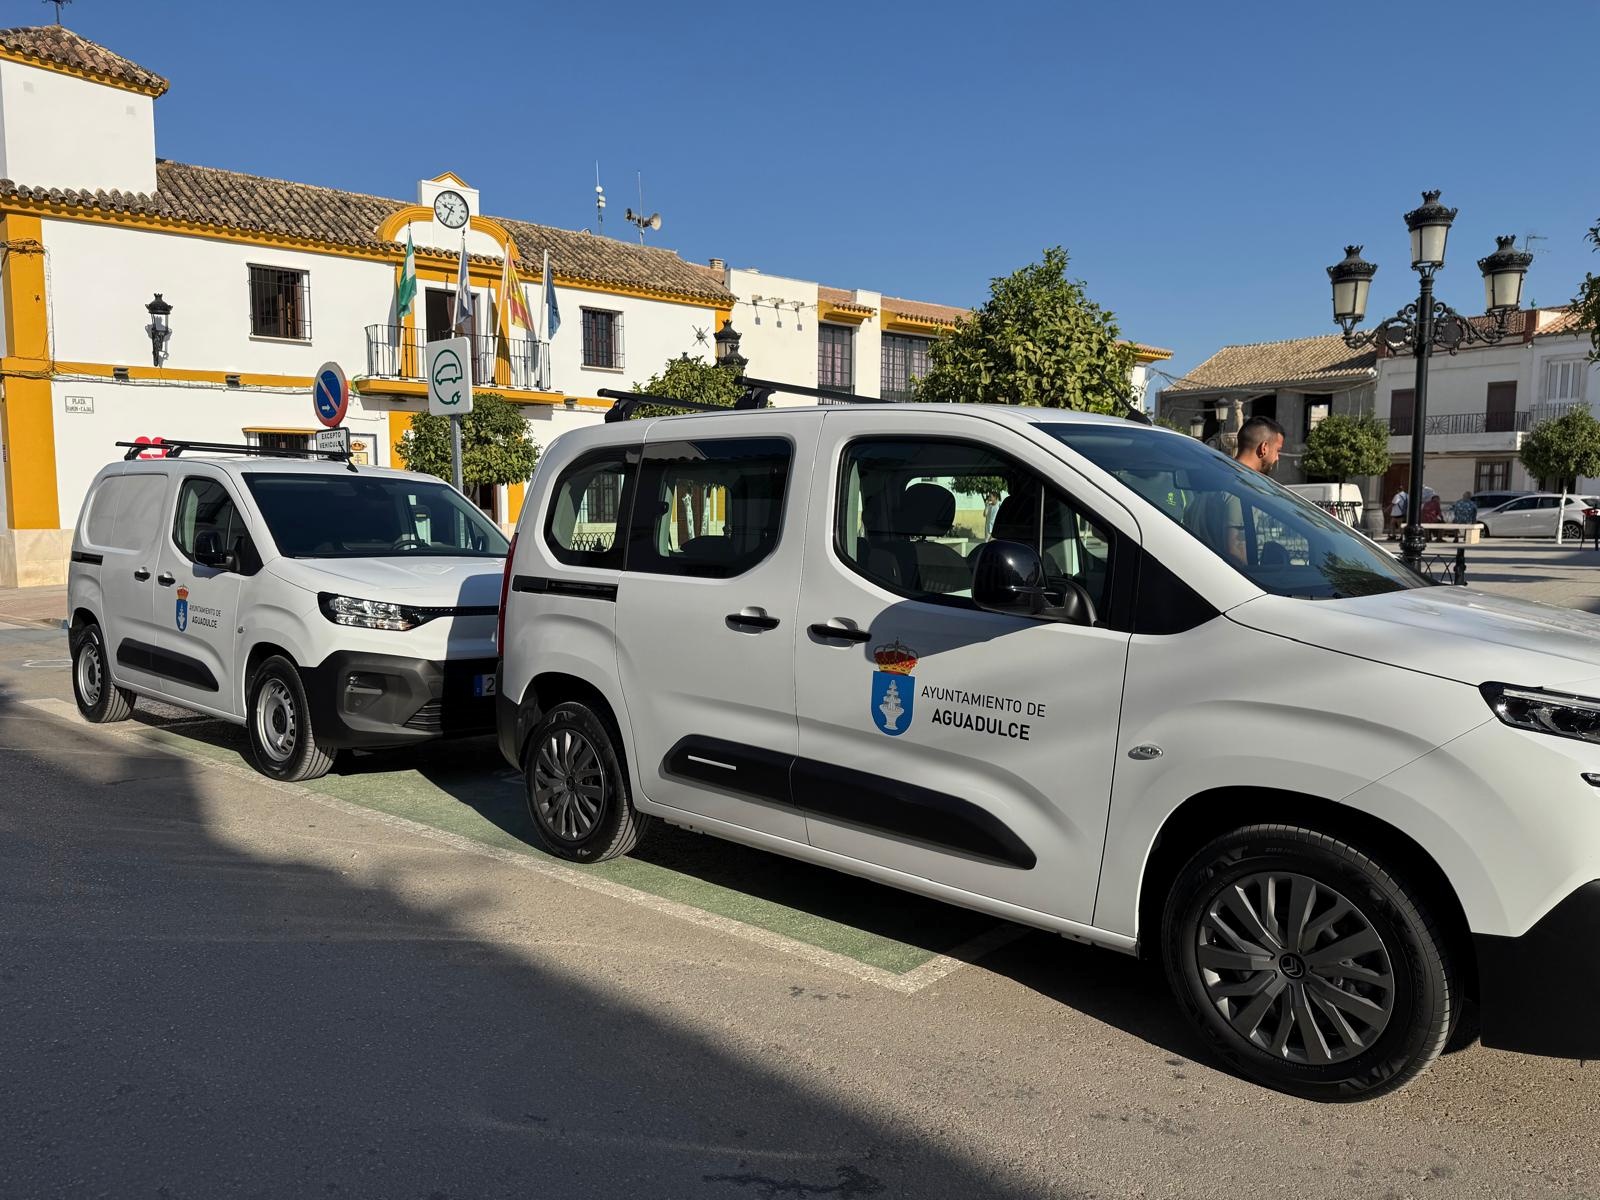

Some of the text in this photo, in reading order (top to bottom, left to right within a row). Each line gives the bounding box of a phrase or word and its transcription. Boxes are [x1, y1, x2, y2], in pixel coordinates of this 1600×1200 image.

[321, 431, 342, 440] EXCEPTO
[216, 609, 221, 617] DE
[192, 615, 217, 629] AGUADULCE
[921, 685, 1046, 718] AYUNTAMIENTO DE
[931, 707, 1031, 741] AGUADULCE
